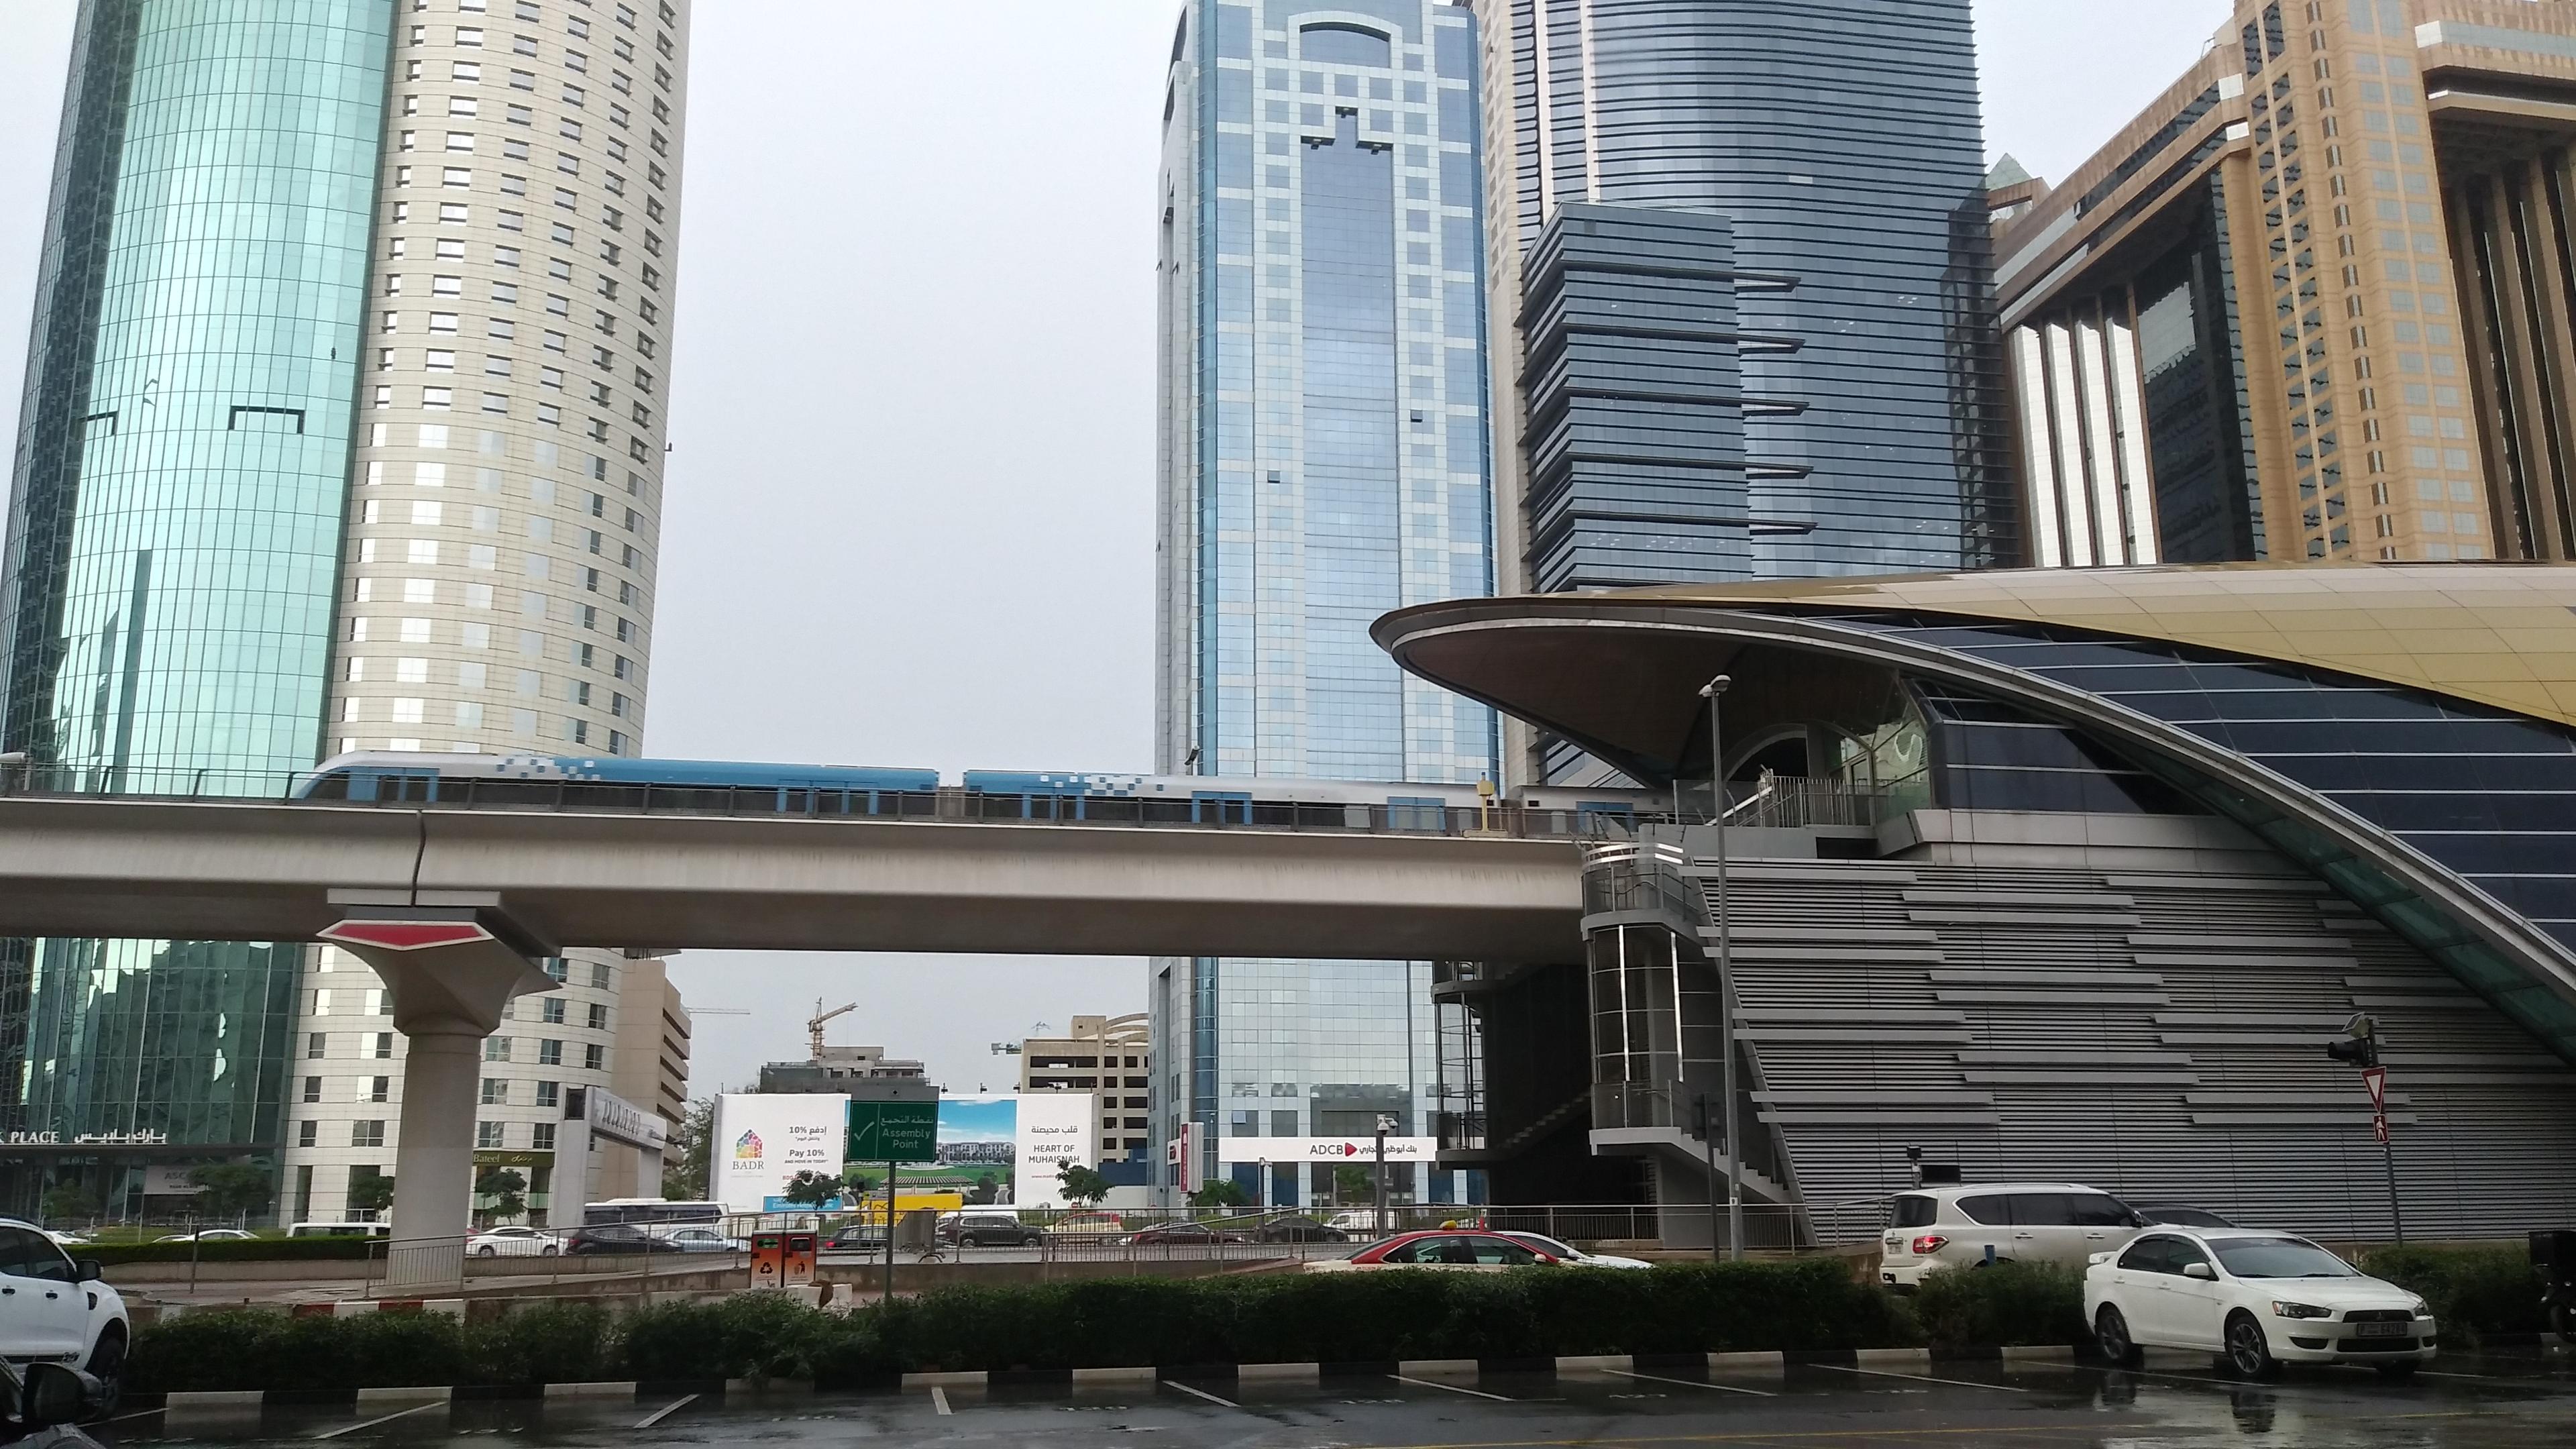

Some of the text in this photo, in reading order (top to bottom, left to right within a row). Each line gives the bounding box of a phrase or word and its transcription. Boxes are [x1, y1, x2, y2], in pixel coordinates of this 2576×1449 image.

[882, 1128, 931, 1139] Assembly
[1031, 1125, 1078, 1135] قلب محيصنة
[11, 1131, 59, 1143] PLACE
[893, 1140, 918, 1148] Point
[1034, 1144, 1075, 1152] HEART OF
[790, 1149, 804, 1158] Pay
[1309, 1145, 1343, 1155] ADCB
[474, 1154, 500, 1163] Bateel
[1028, 1155, 1080, 1163] MUHAISNAH
[732, 1161, 765, 1170] BADR
